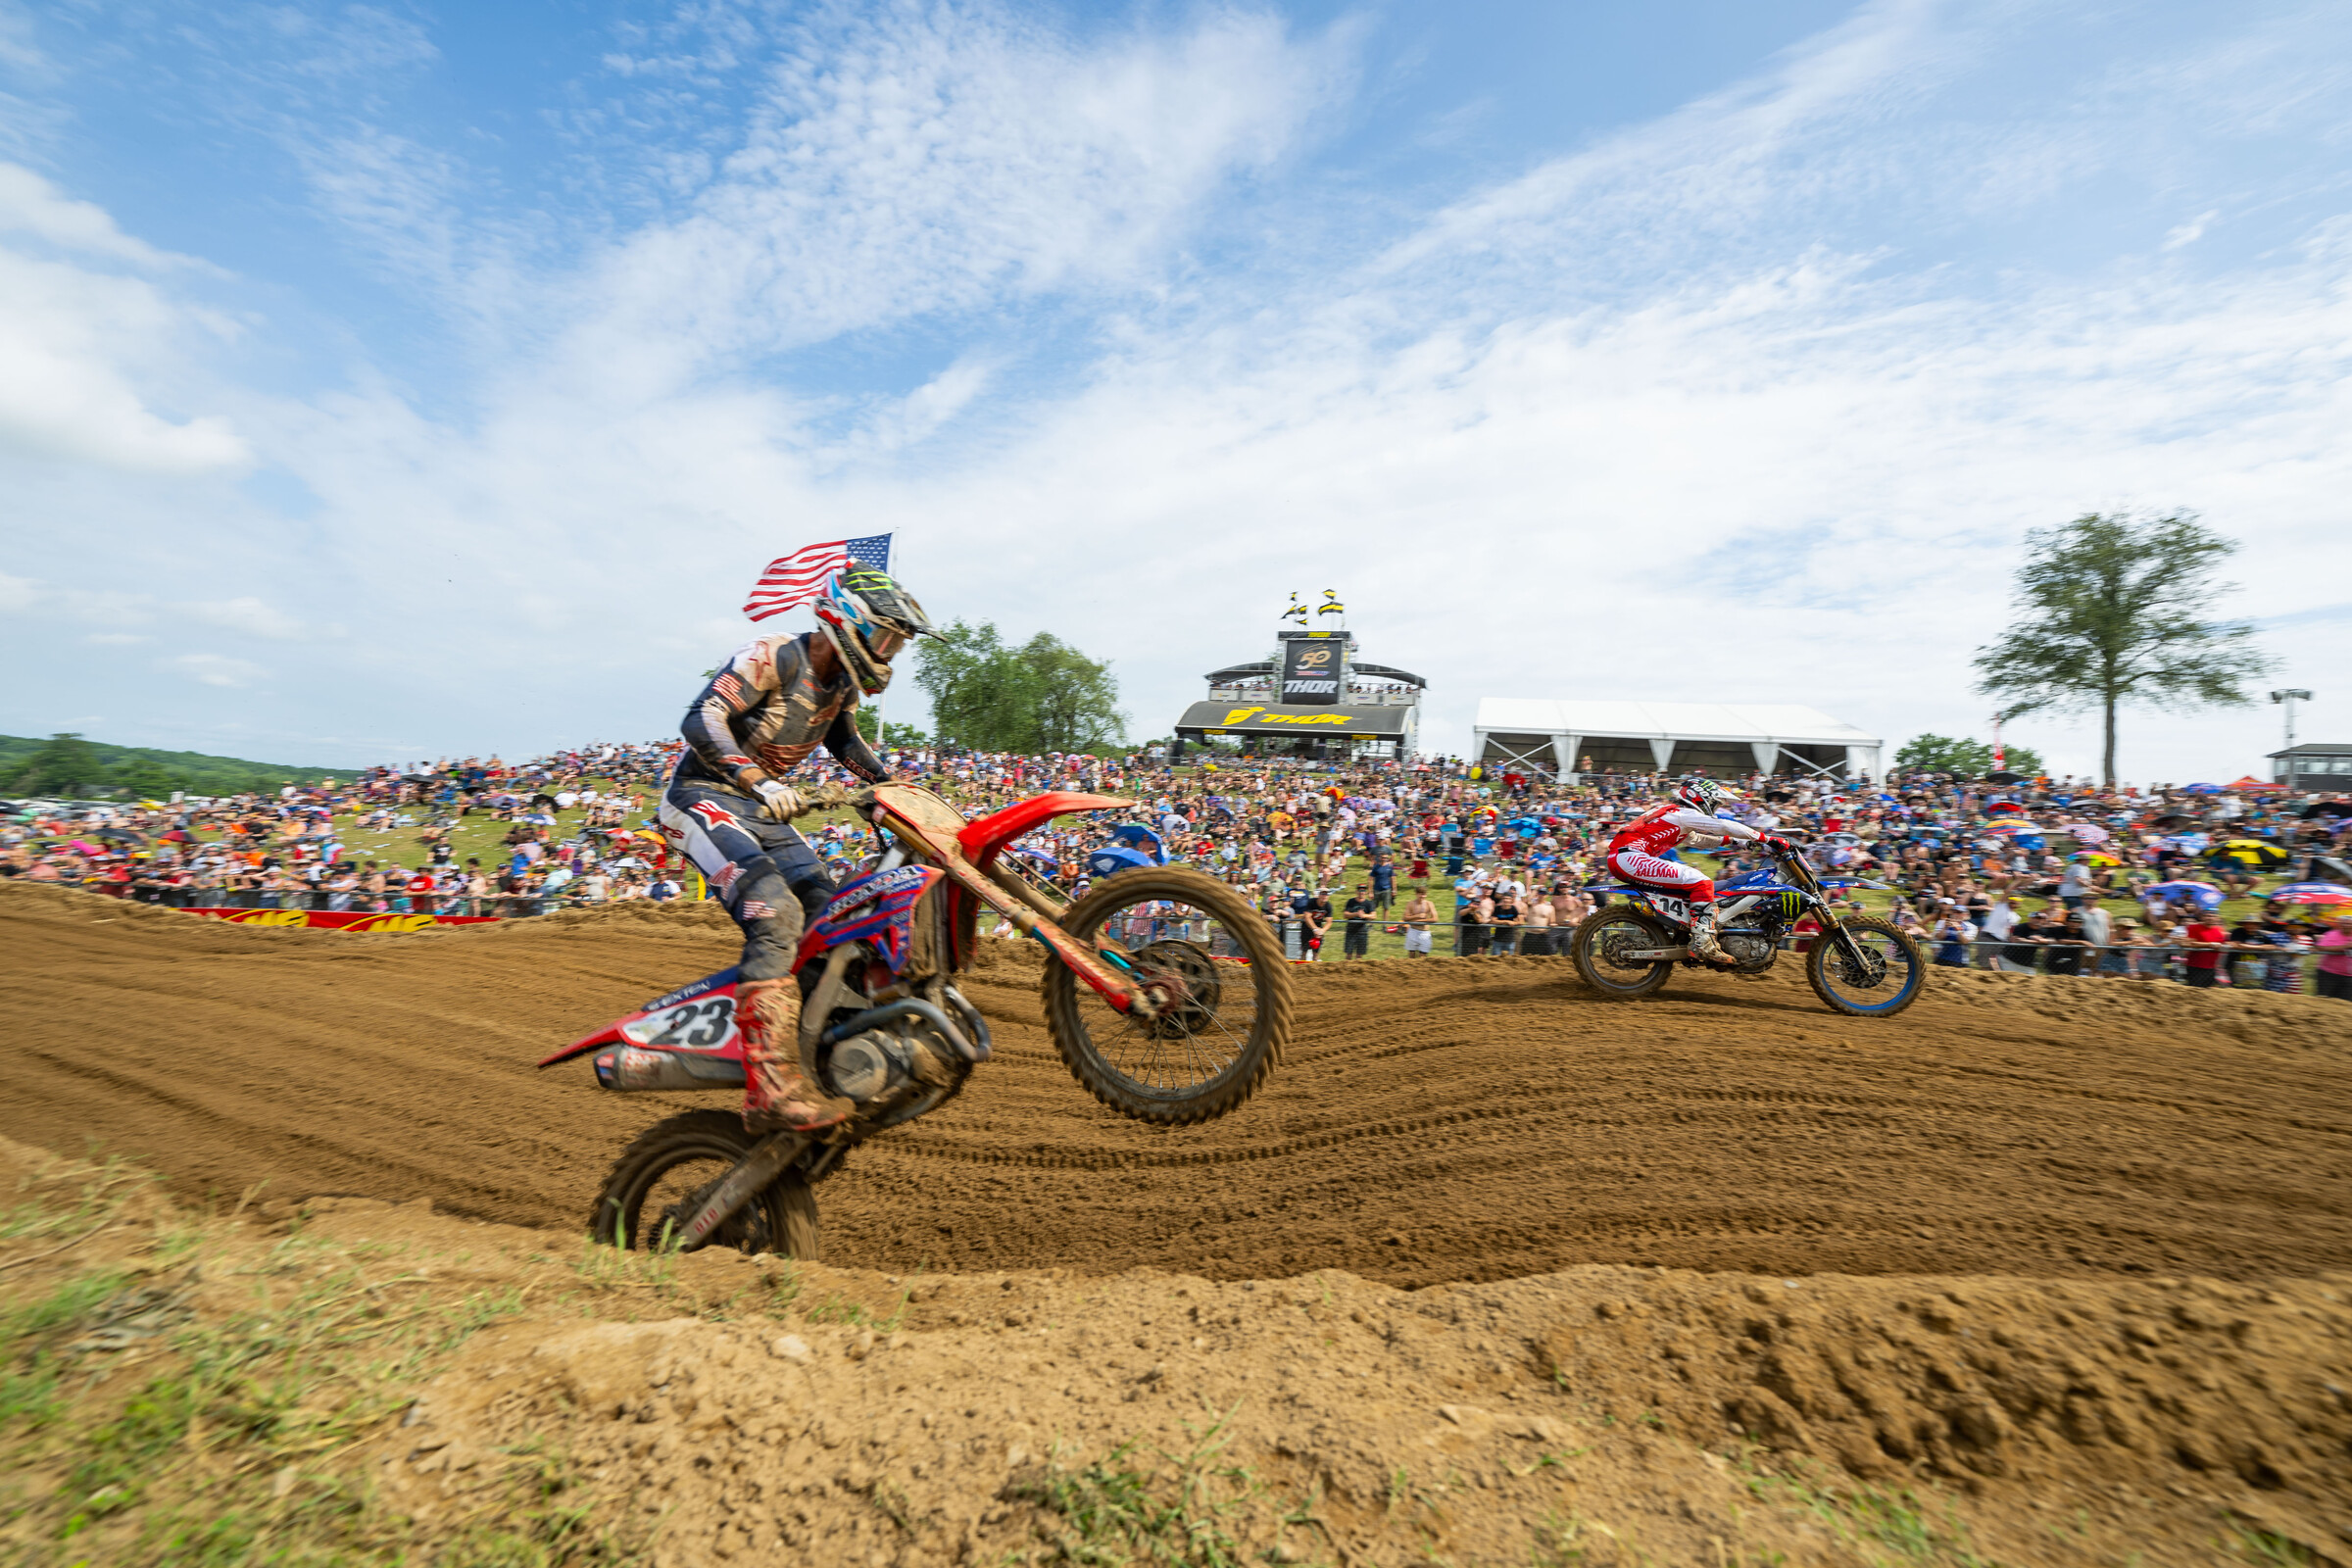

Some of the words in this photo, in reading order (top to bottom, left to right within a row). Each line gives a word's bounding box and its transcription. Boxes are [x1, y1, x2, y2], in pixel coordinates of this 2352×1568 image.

[1295, 650, 1332, 669] 50
[1283, 680, 1339, 693] THOR
[1259, 713, 1353, 725] THOR
[1659, 897, 1684, 916] 14
[648, 999, 733, 1046] 23
